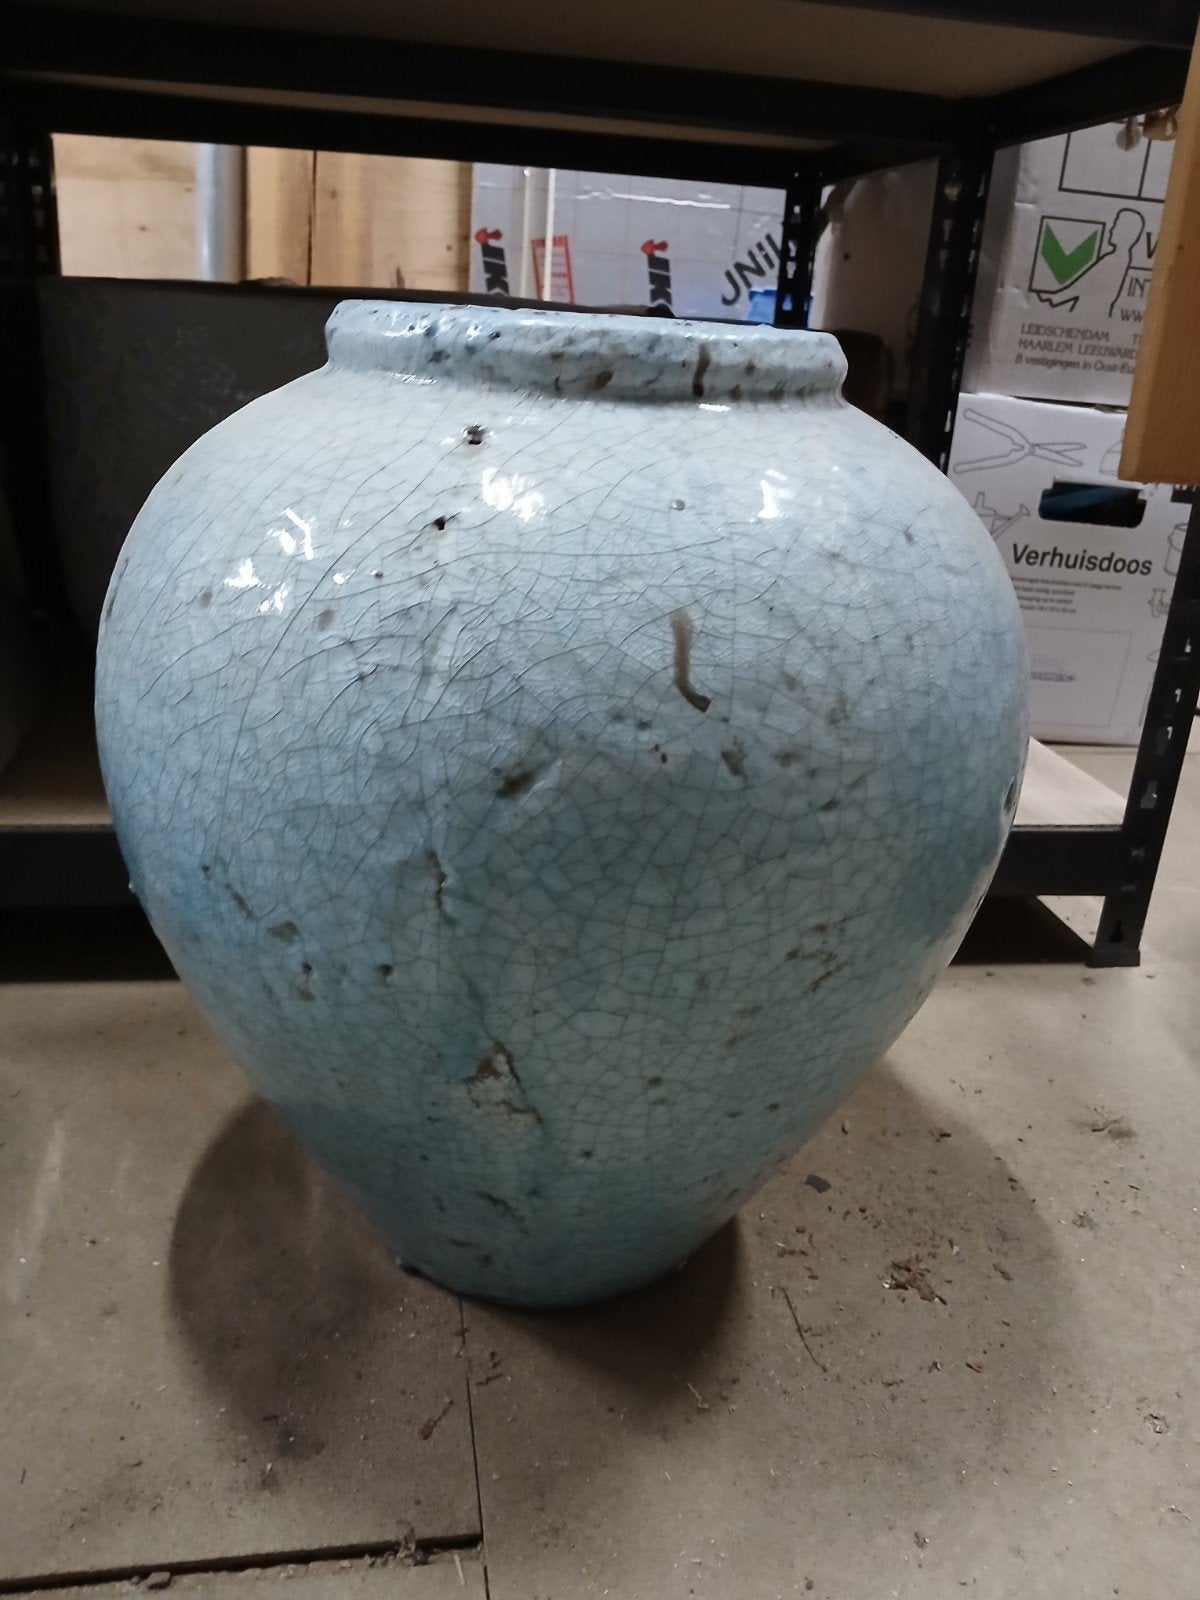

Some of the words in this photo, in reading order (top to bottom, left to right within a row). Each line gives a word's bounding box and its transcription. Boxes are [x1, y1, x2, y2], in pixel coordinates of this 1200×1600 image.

[481, 243, 509, 296] IK
[1020, 323, 1110, 342] LEIDSCHENDAM
[1018, 338, 1073, 353] HAARLEM
[1082, 360, 1092, 370] in
[1012, 543, 1153, 576] Verhuisdoos
